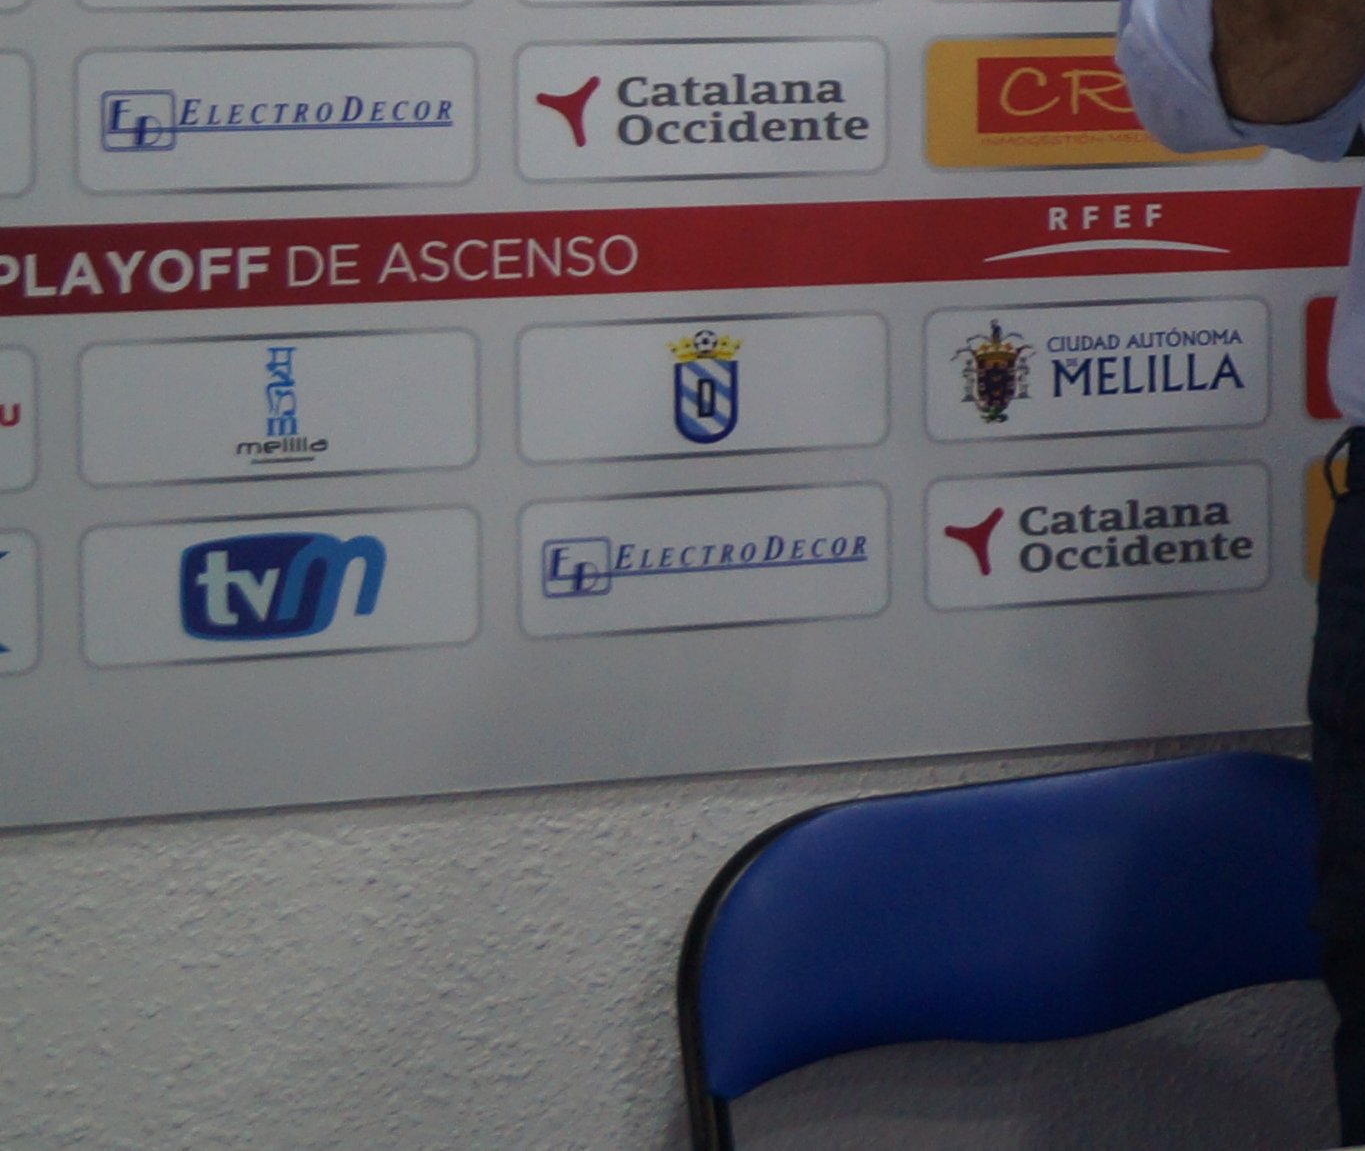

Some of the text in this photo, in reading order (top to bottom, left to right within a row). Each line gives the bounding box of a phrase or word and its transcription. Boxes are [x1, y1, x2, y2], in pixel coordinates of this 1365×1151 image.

[617, 73, 845, 108] Catalana
[1001, 67, 1135, 117] CR
[617, 110, 870, 145] Occidente
[1049, 203, 1164, 232] RFEF
[0, 234, 639, 298] PLAYOFF DE ASCENSO
[1047, 327, 1243, 352] CIUDAD AUTÓNOMA
[1051, 352, 1245, 397] MELILLA
[236, 436, 328, 455] melilla
[1019, 498, 1230, 536] Catalana
[1018, 531, 1253, 574] Occidente
